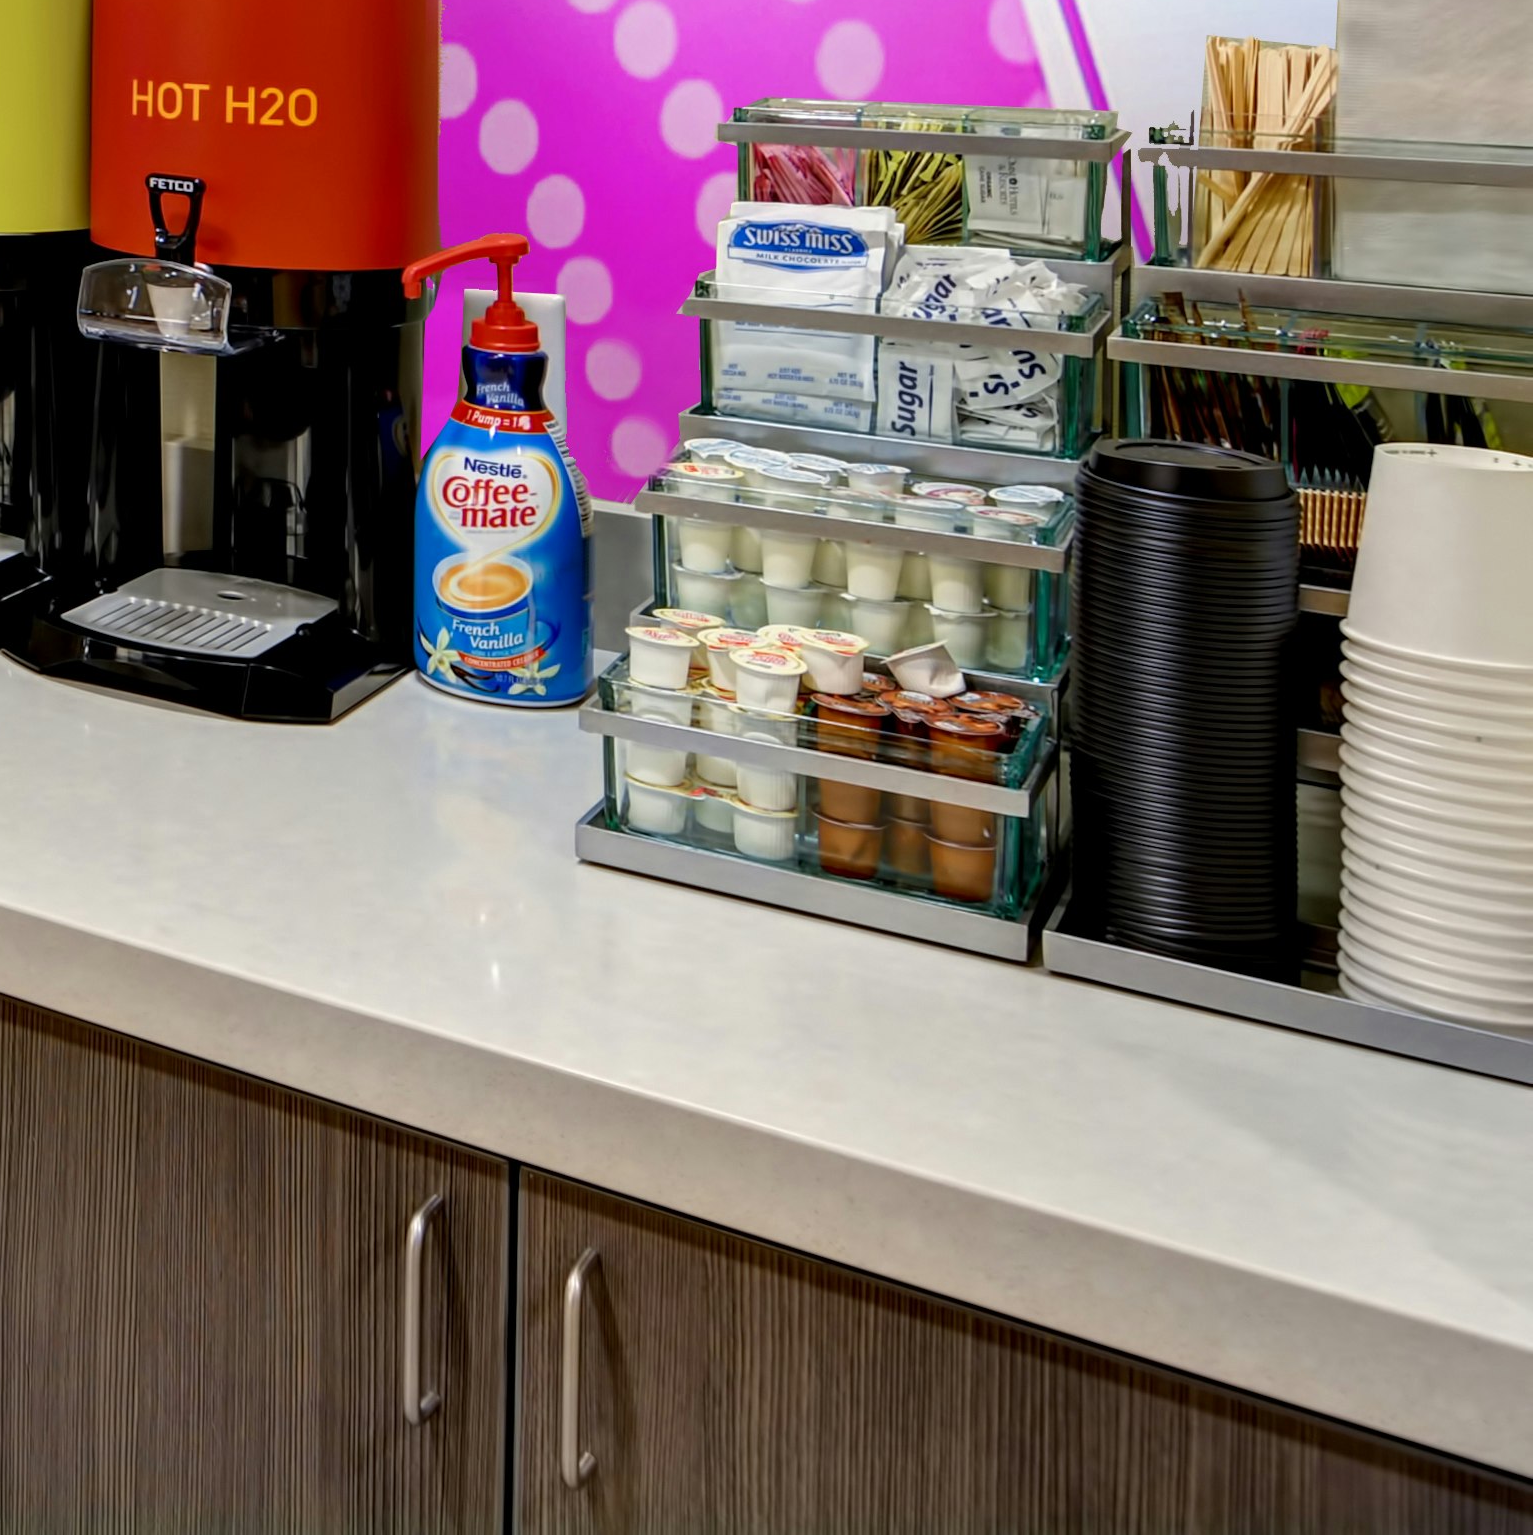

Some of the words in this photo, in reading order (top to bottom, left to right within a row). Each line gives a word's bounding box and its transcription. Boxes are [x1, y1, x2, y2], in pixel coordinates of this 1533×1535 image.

[132, 78, 211, 122] HOT
[148, 176, 195, 193] FETCO
[742, 226, 801, 247] SWISS
[755, 252, 779, 261] MILK
[782, 254, 840, 265] CHOCOLATE
[476, 381, 511, 398] French
[891, 360, 924, 437] Sugar
[485, 392, 525, 408] Vanilla
[471, 409, 501, 428] Pump
[461, 504, 537, 529] mate
[451, 618, 500, 637] French
[469, 632, 525, 650] Vanilla
